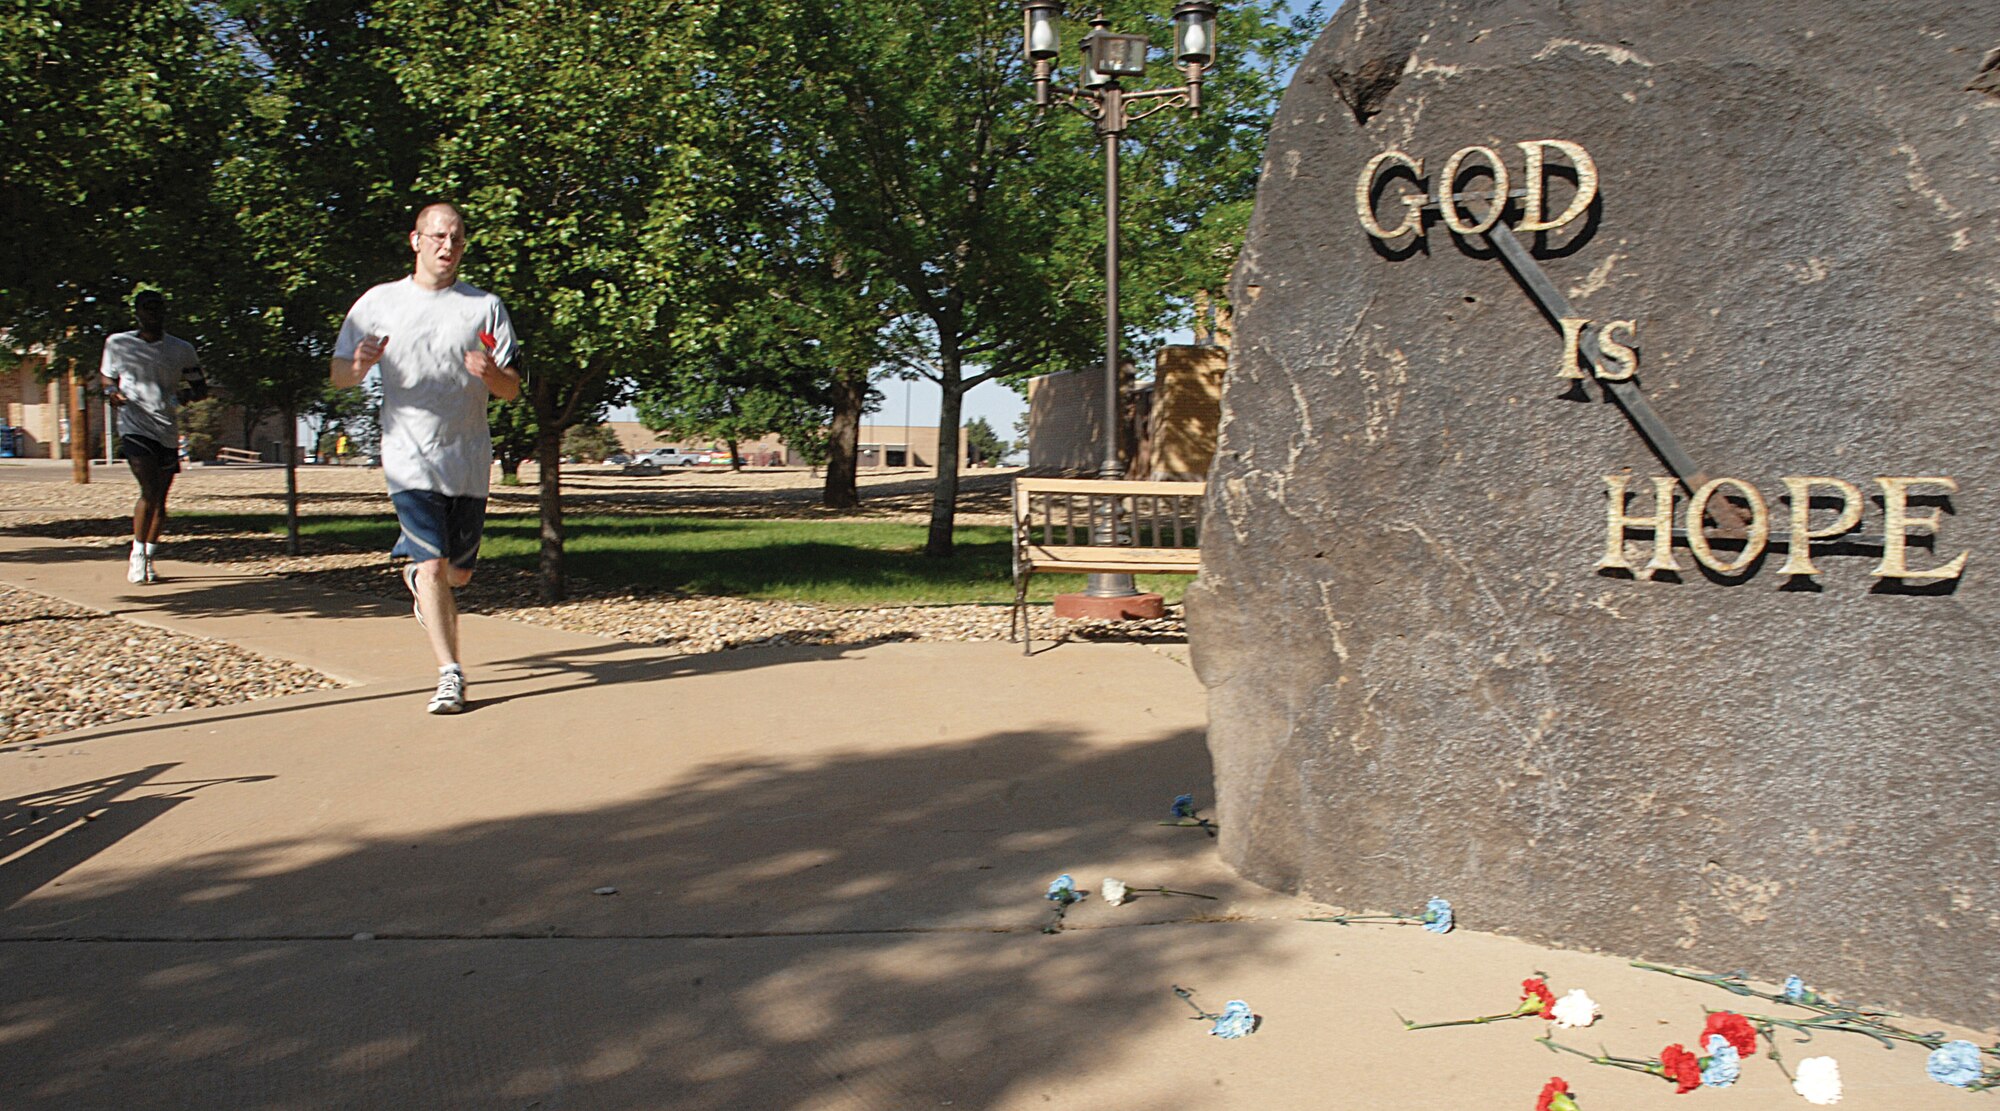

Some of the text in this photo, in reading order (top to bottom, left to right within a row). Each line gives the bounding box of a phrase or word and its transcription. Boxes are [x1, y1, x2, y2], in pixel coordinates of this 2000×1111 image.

[1355, 139, 1599, 240] GOD
[1555, 318, 1638, 381] IS
[1593, 475, 1969, 580] HOPE
